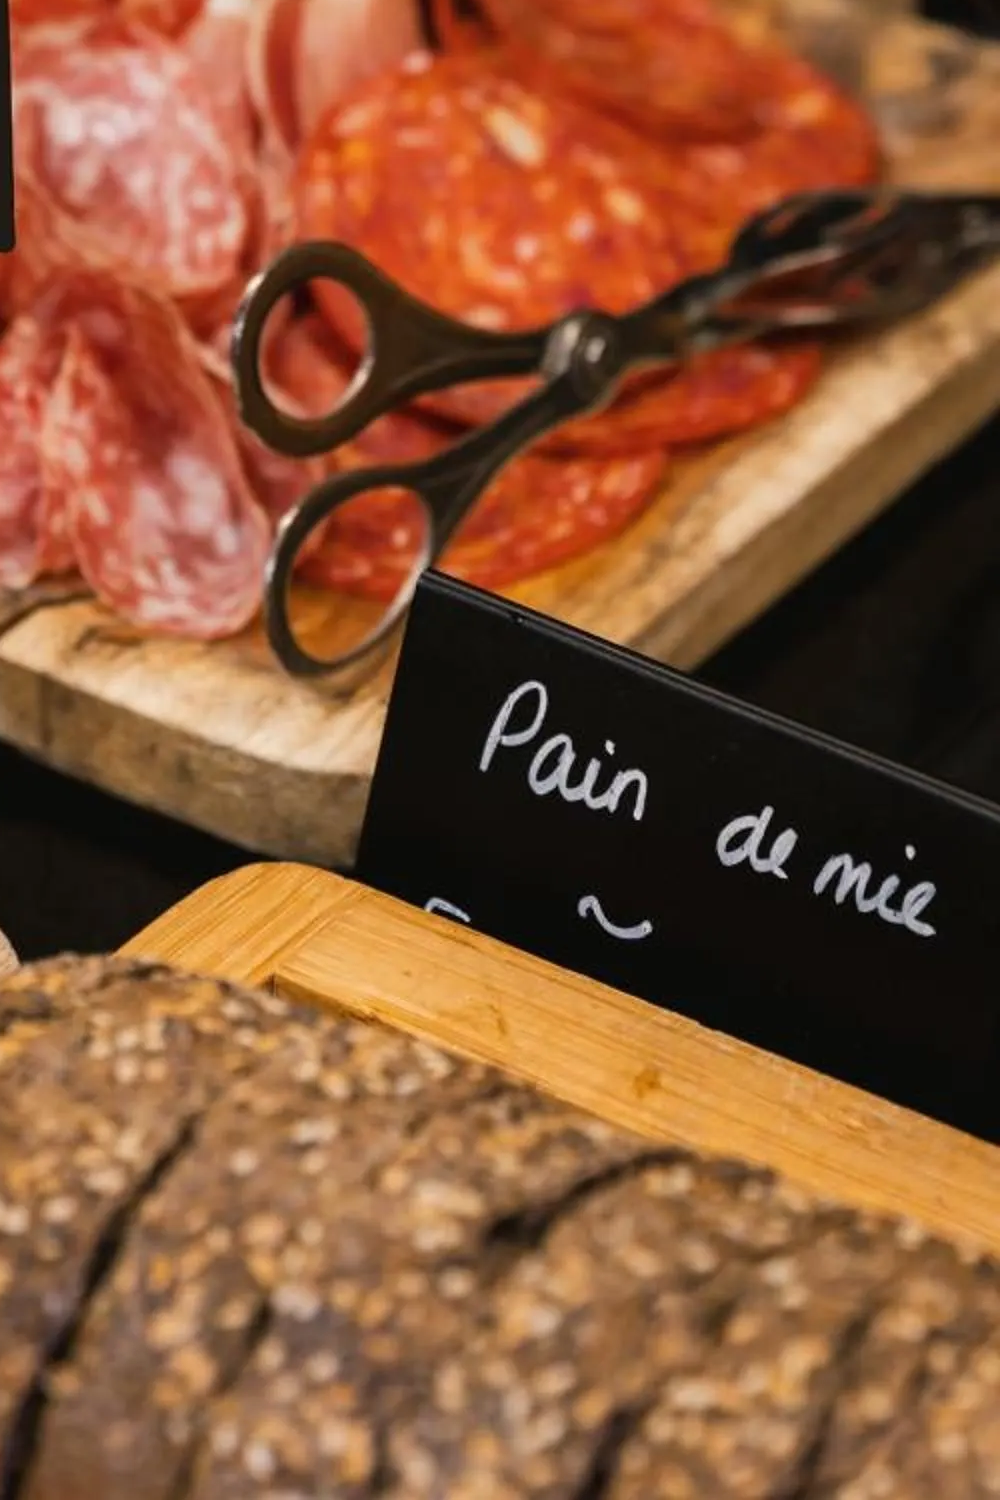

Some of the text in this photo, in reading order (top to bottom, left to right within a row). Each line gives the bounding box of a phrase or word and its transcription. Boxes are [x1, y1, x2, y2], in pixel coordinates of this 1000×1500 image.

[479, 680, 937, 937] Pain de mie
